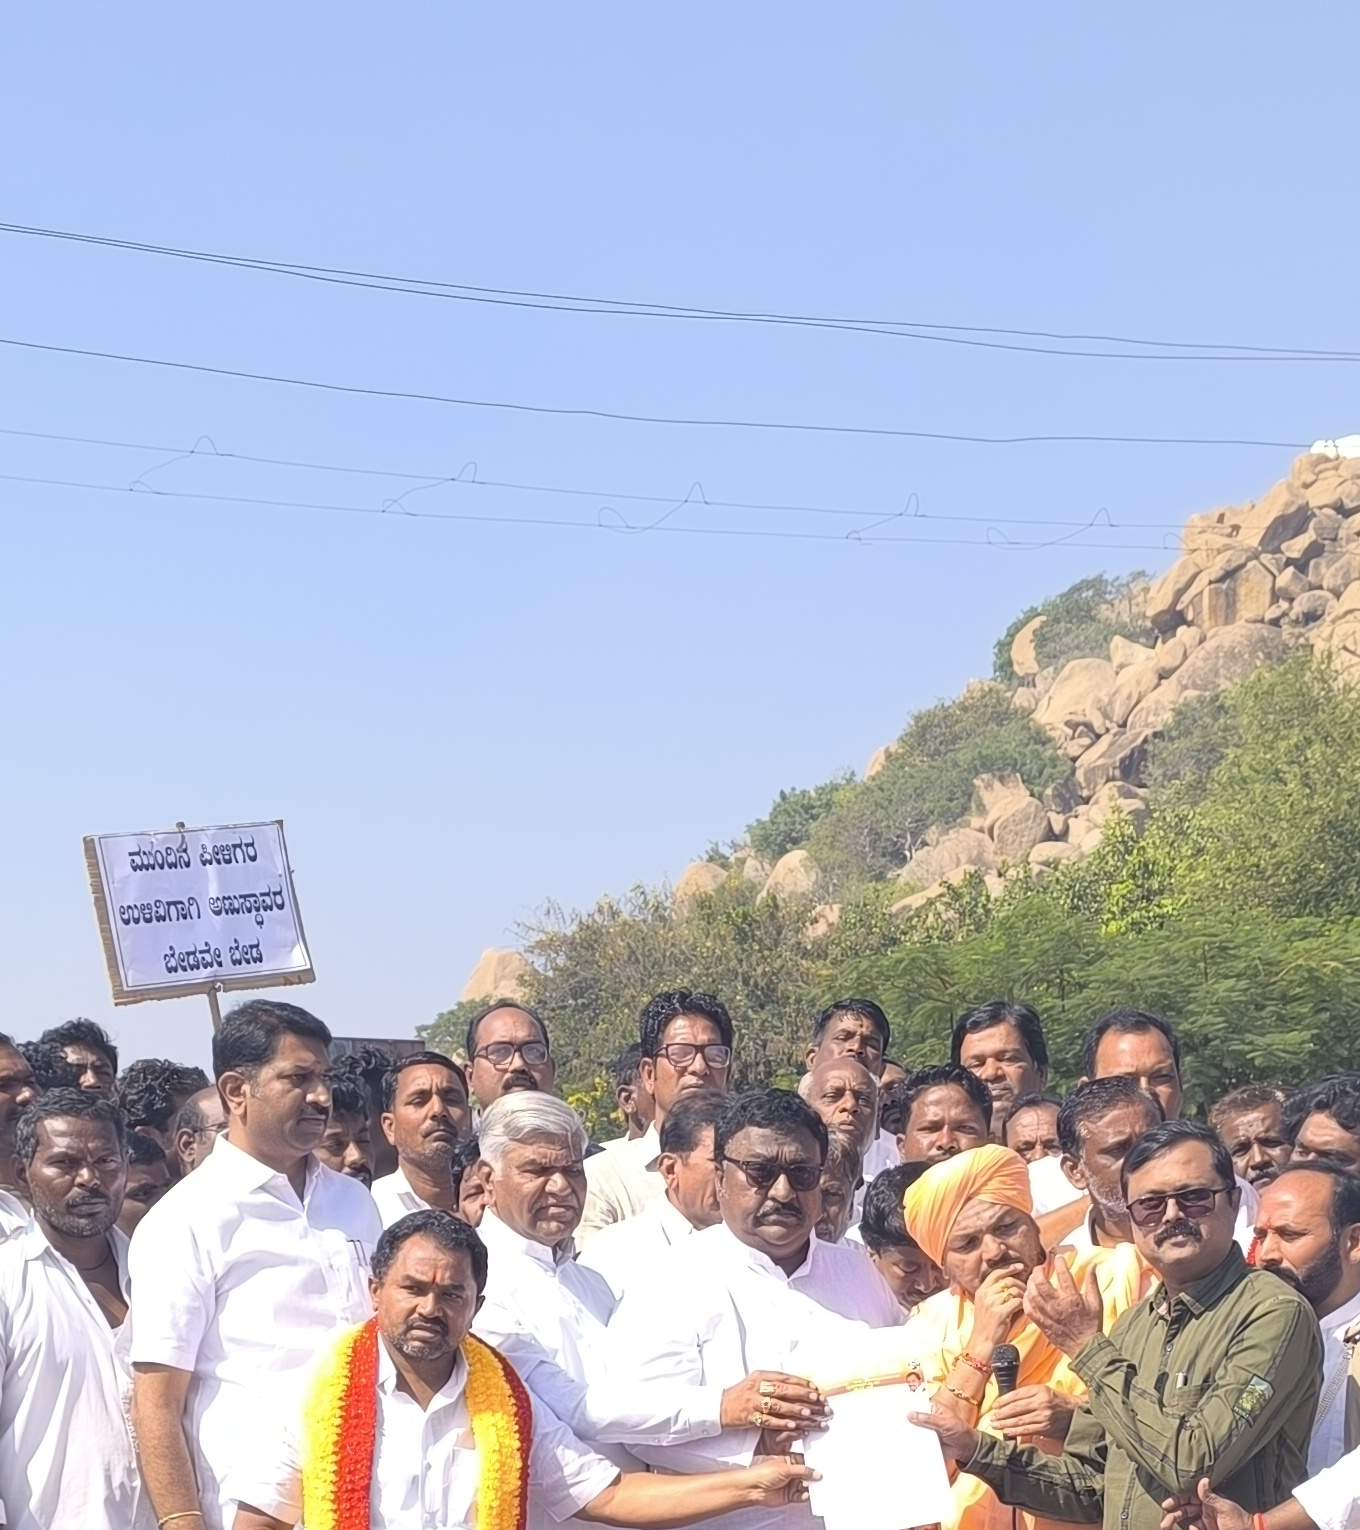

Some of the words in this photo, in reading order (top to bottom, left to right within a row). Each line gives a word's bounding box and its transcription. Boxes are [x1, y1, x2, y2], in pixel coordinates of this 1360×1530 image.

[128, 842, 191, 872] ಮುಂದಿನ
[119, 897, 201, 926] ಉಳಿವಿಗಾಗಿ
[209, 884, 285, 929] ಅಣುಸ್ಥಾವರ
[164, 941, 223, 974] ಬೇಡವೇ
[229, 937, 263, 966] ಬೇಡ
